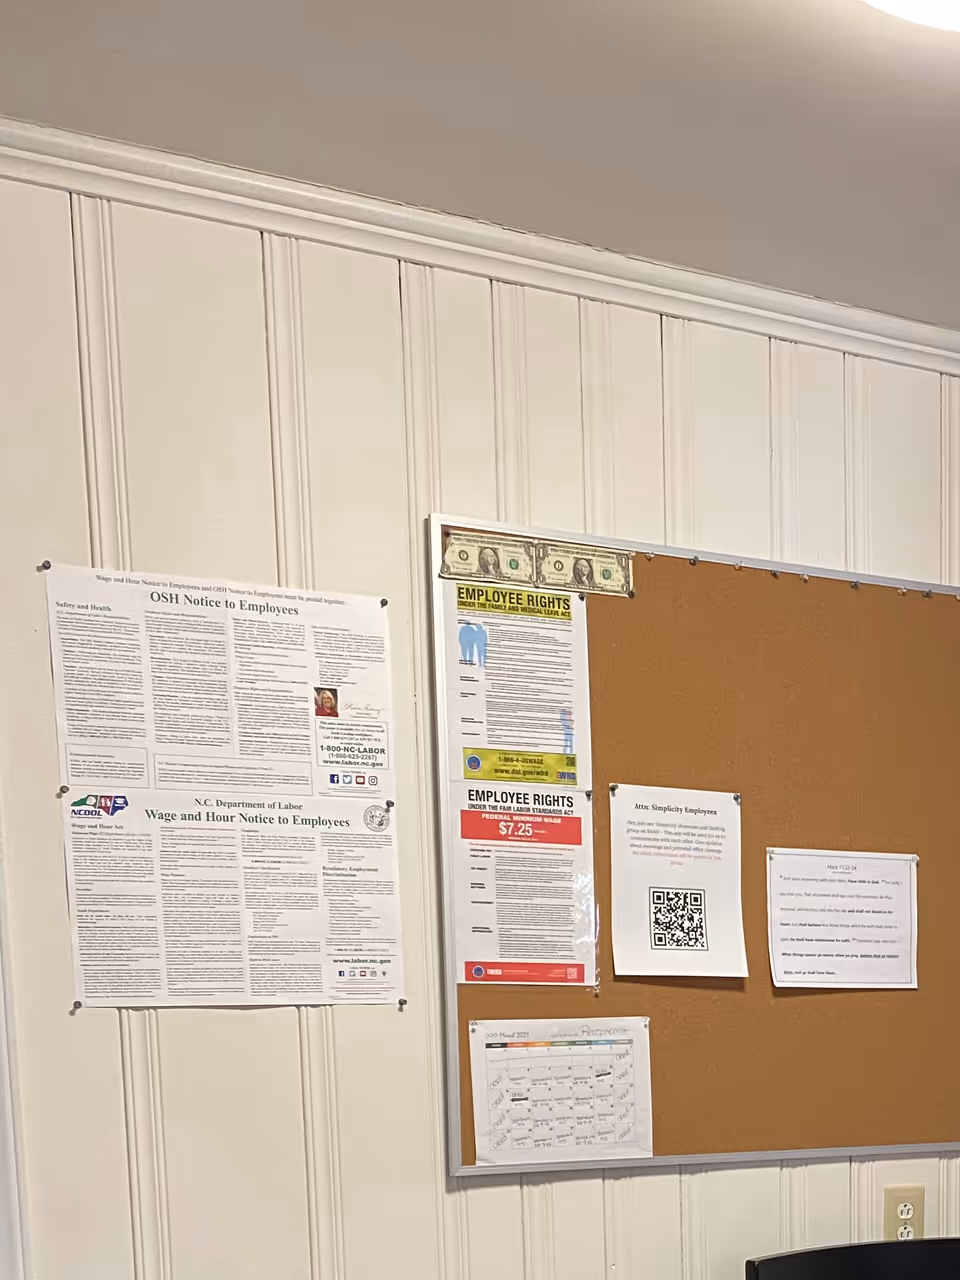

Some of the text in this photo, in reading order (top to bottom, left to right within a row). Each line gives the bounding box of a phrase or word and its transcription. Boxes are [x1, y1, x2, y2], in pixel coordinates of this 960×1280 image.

[56, 601, 75, 609] Safety
[150, 591, 299, 616] OSH Notice to Employees
[458, 587, 570, 610] EMPLOYEE RIGHTS
[520, 606, 542, 614] MEDICAL
[320, 745, 386, 754] 1-800-NC-LABOR
[195, 798, 213, 806] N.C.
[216, 799, 265, 809] Department
[278, 802, 303, 810] Labor
[468, 789, 574, 808] EMPLOYEE RIGHTS
[651, 804, 682, 814] Simplicity
[684, 806, 717, 816] Employees
[145, 809, 350, 828] Wage and Hour Notice to Employees
[499, 821, 532, 836] $7.25
